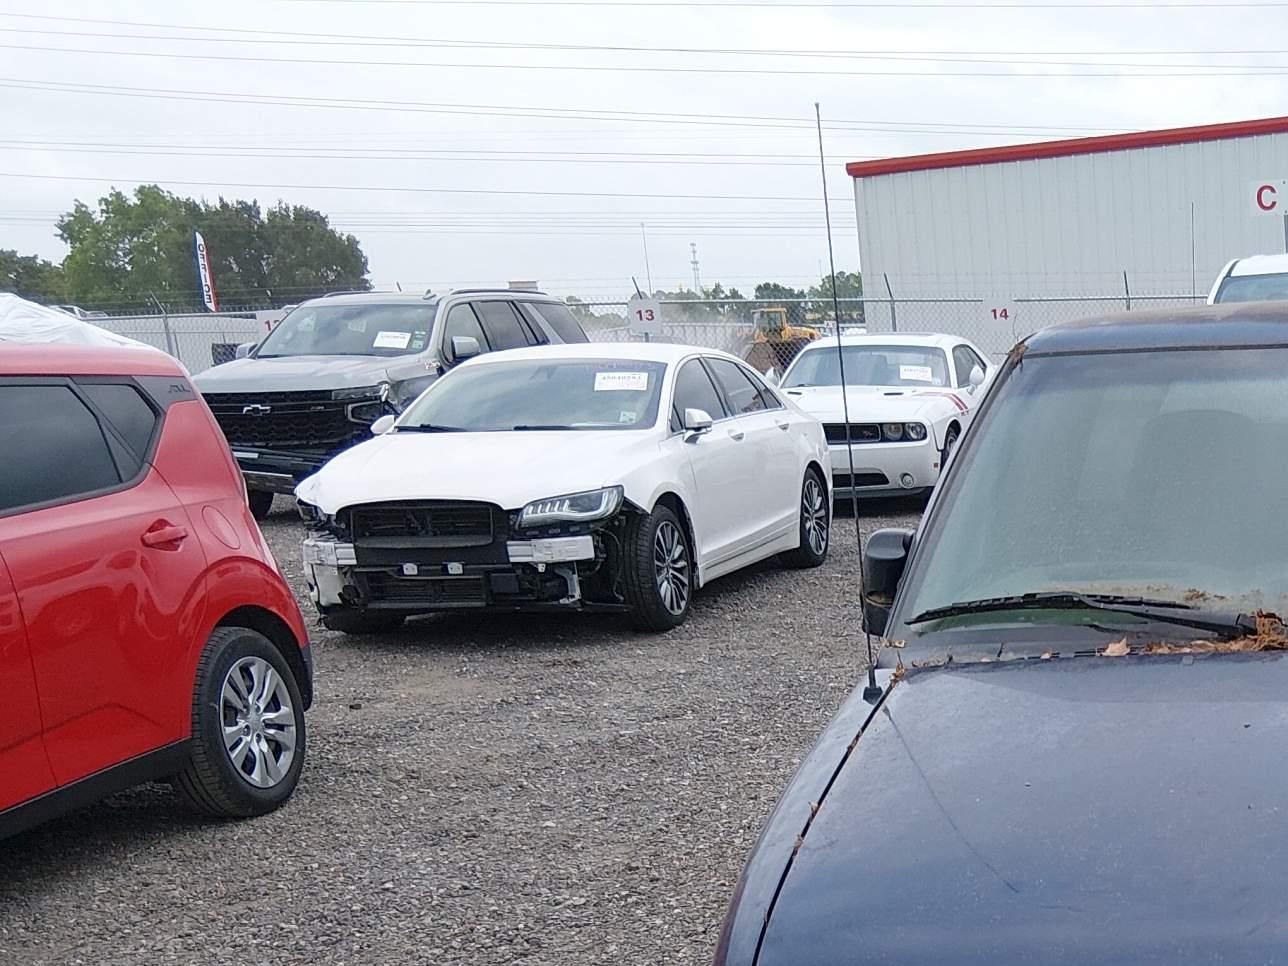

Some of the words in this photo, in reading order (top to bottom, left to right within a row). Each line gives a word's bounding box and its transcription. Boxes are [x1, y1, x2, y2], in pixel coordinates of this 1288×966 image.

[1256, 184, 1277, 211] C
[636, 309, 655, 321] 13
[991, 308, 1009, 320] 14
[264, 319, 280, 331] 1
